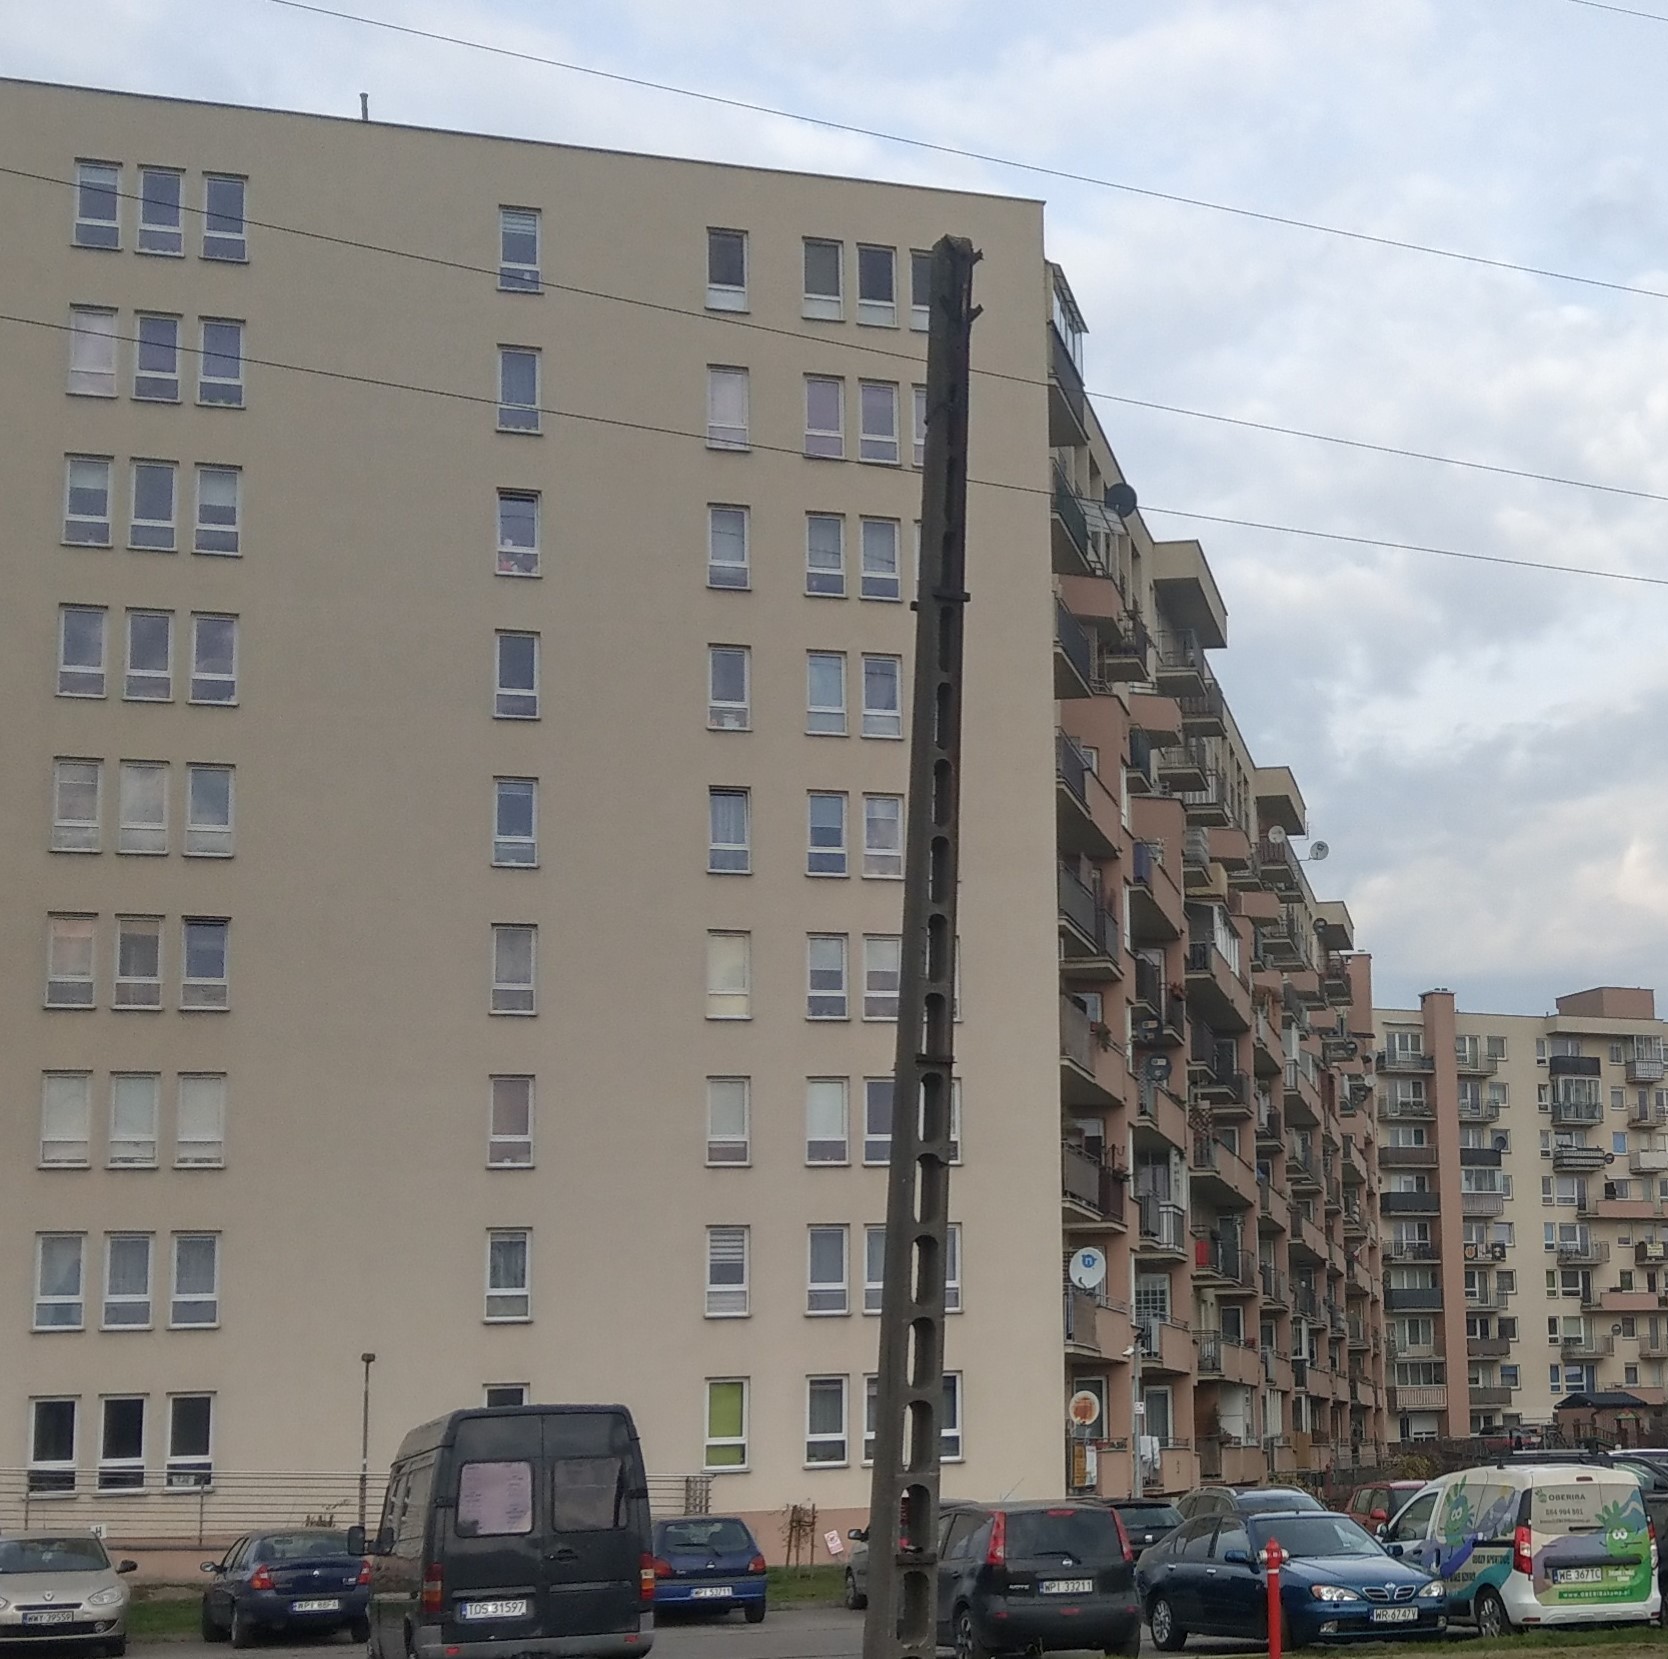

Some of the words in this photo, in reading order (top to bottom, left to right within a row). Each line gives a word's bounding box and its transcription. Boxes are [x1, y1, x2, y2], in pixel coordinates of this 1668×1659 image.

[1559, 1571, 1573, 1580] WE
[1045, 1583, 1060, 1592] WPI
[1065, 1581, 1092, 1591] 33211
[469, 1604, 488, 1615] TOS
[491, 1602, 524, 1613] 31597
[1376, 1609, 1388, 1619] WR
